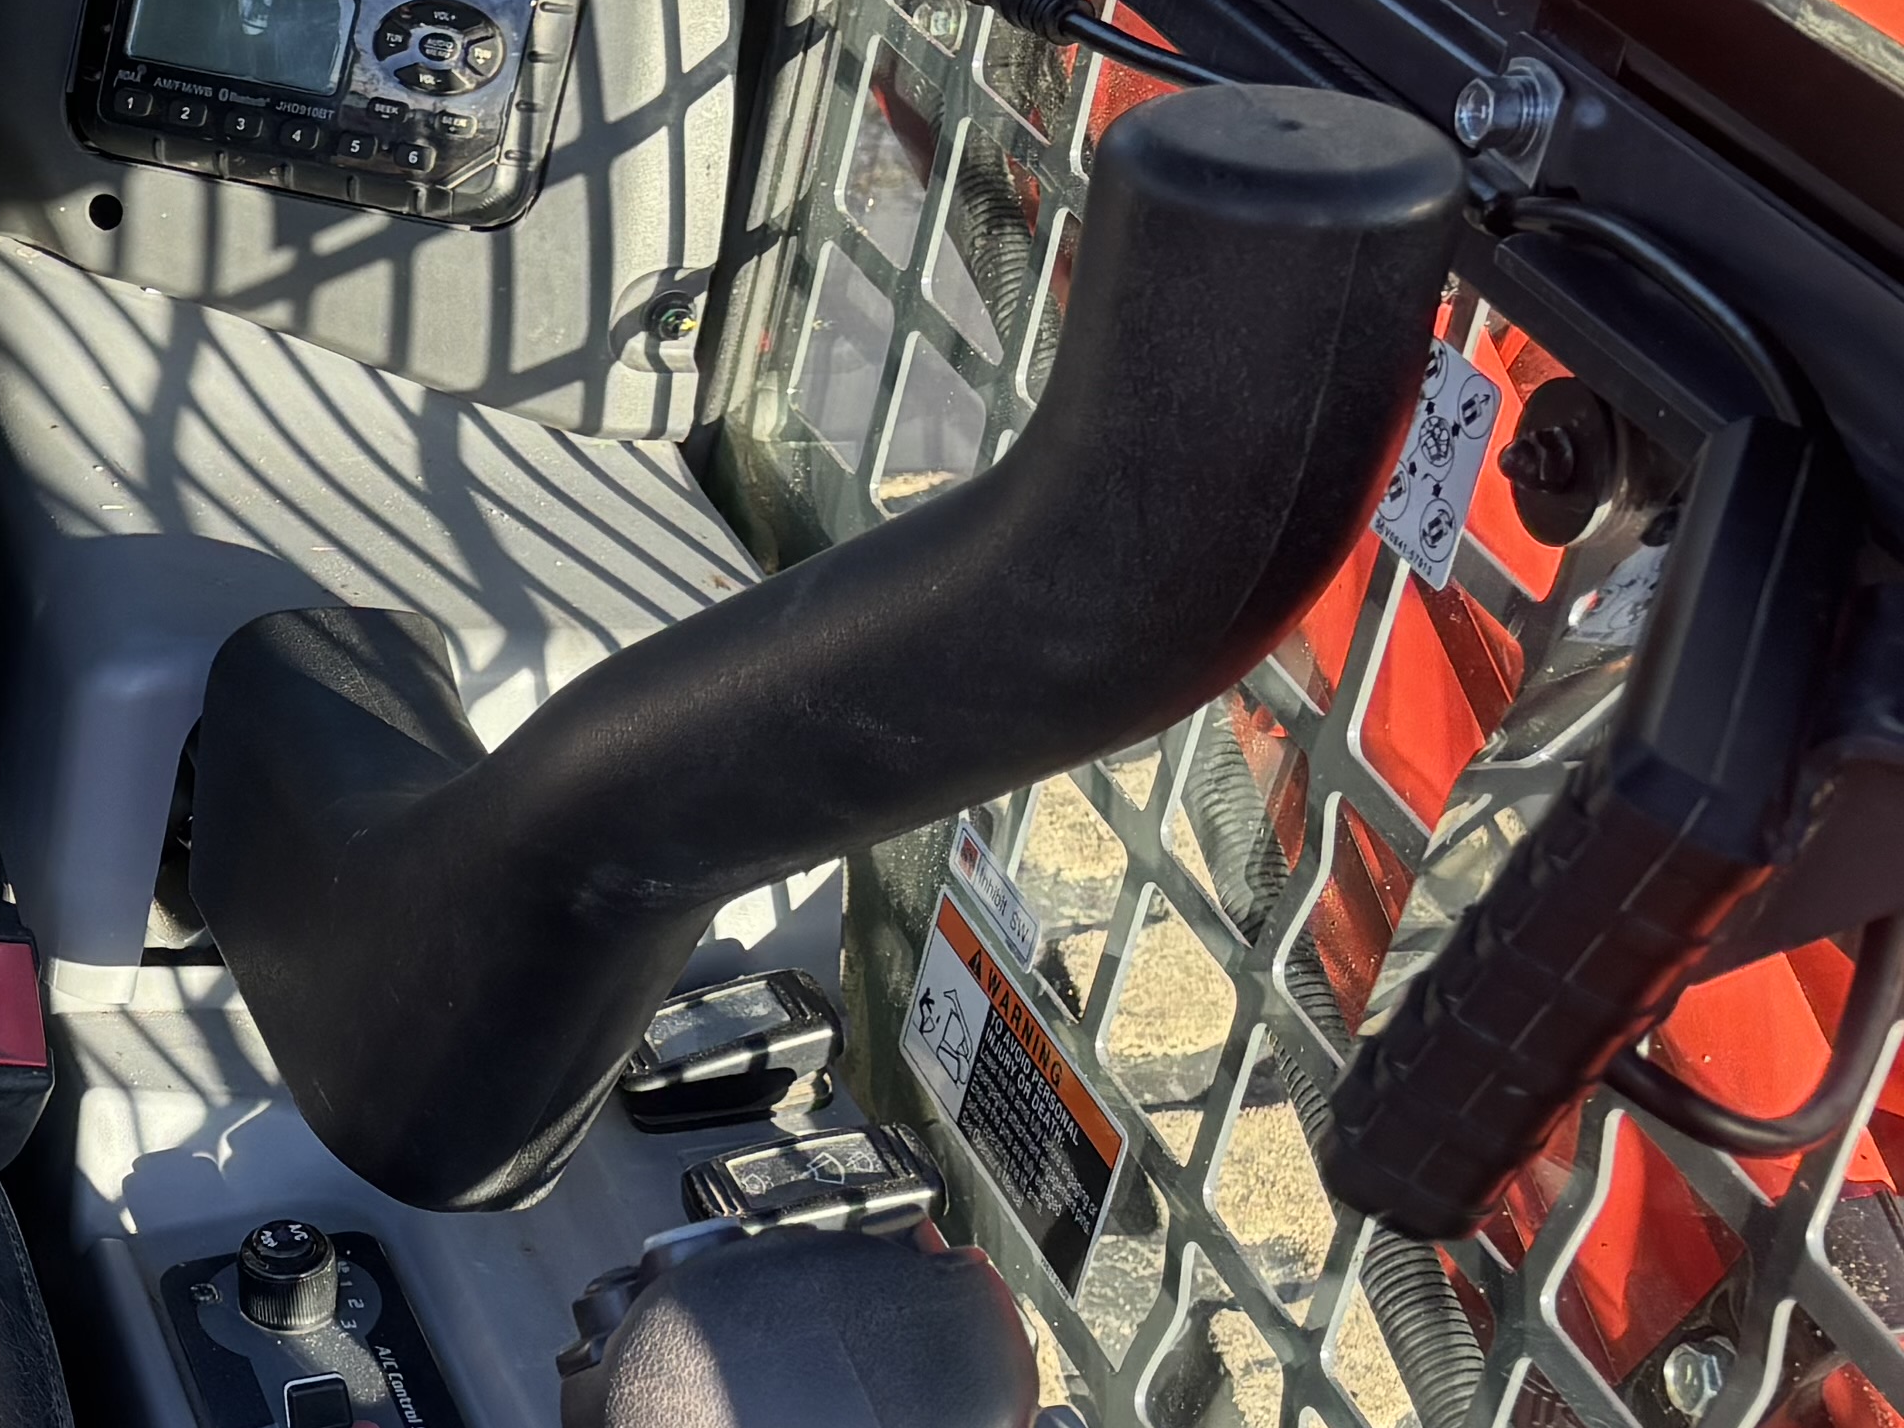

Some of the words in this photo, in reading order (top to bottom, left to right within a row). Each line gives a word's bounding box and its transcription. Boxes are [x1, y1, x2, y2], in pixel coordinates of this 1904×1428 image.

[978, 865, 1008, 917] Inhibit
[1008, 907, 1029, 944] SW
[986, 966, 1062, 1089] WARNING
[984, 1026, 1018, 1076] INJURY
[1016, 1072, 1032, 1099] OR
[1030, 1092, 1065, 1153] DEATH:
[990, 1009, 1003, 1035] TO
[1002, 1030, 1031, 1074] AVOID
[1030, 1068, 1078, 1146] PERSONAL
[340, 1319, 358, 1329] 3
[347, 1297, 365, 1310] 2
[374, 1345, 398, 1369] A/C
[387, 1372, 423, 1423] Control
